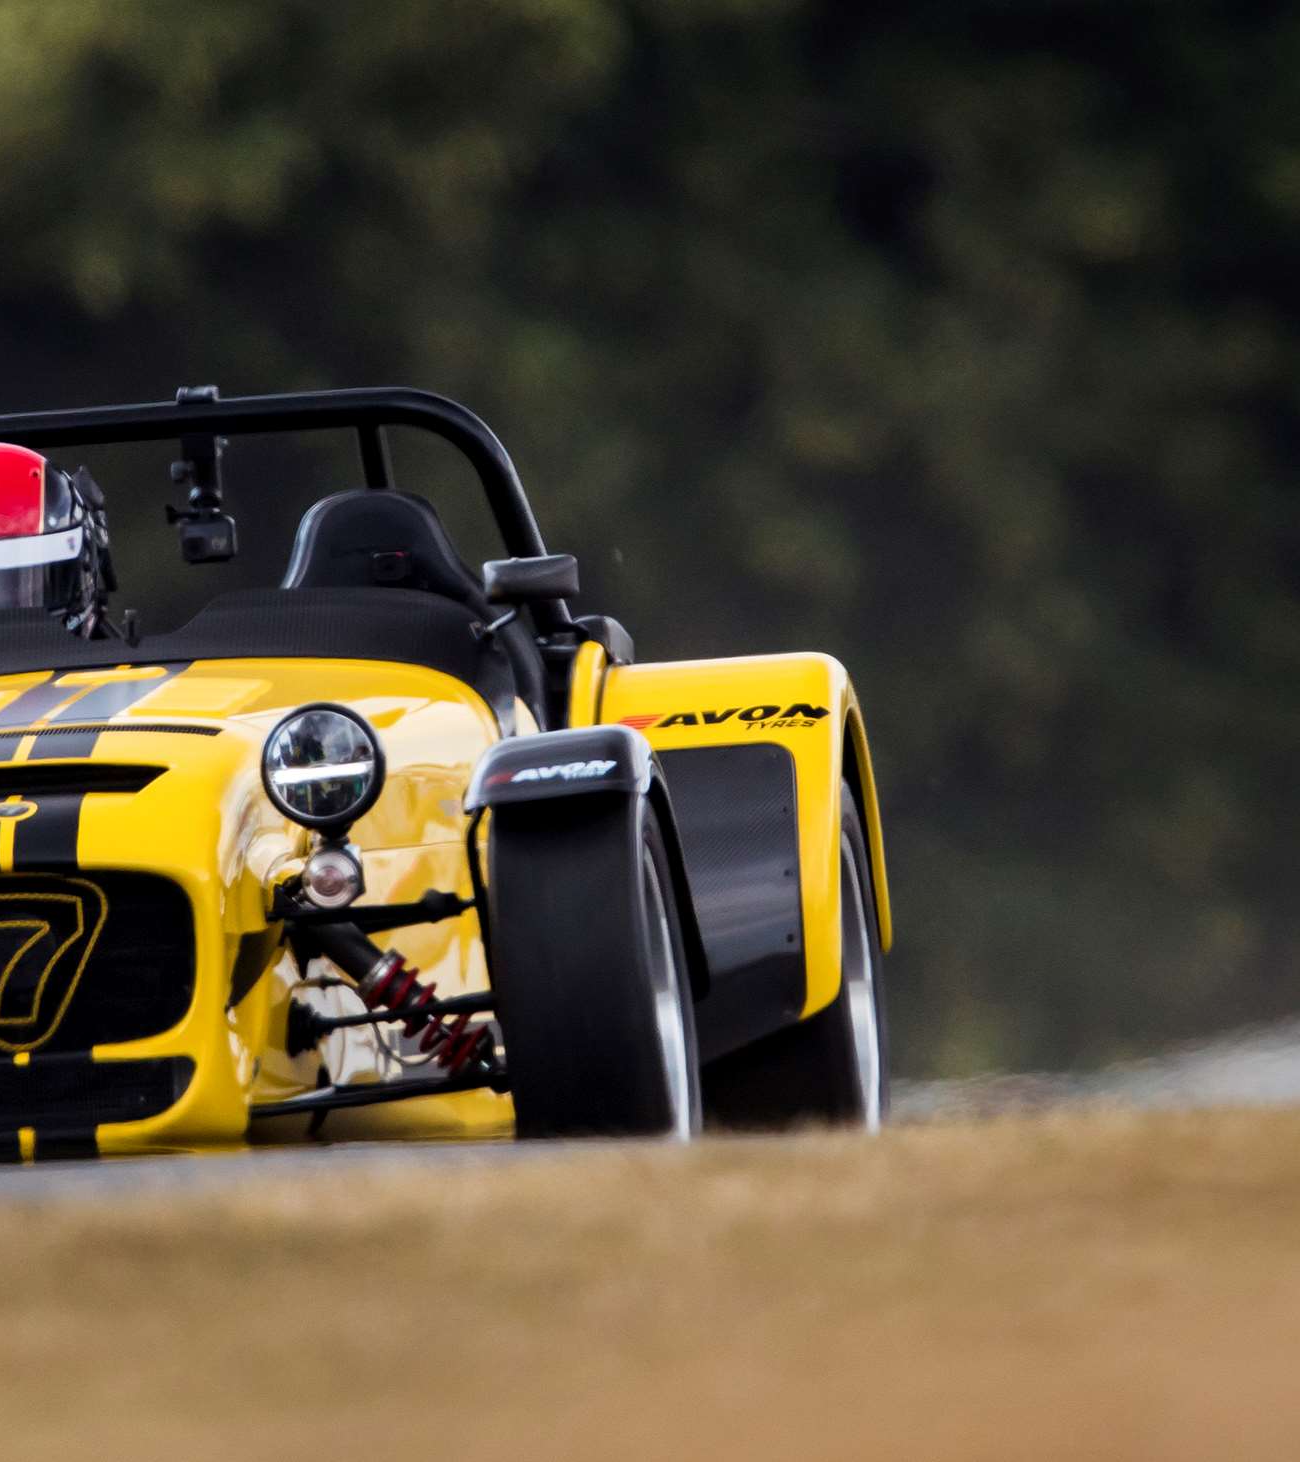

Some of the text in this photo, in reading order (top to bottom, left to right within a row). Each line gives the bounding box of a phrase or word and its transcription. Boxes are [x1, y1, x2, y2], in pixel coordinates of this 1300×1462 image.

[655, 703, 830, 728] AVON
[746, 719, 817, 731] TYRES
[511, 760, 617, 782] AVON
